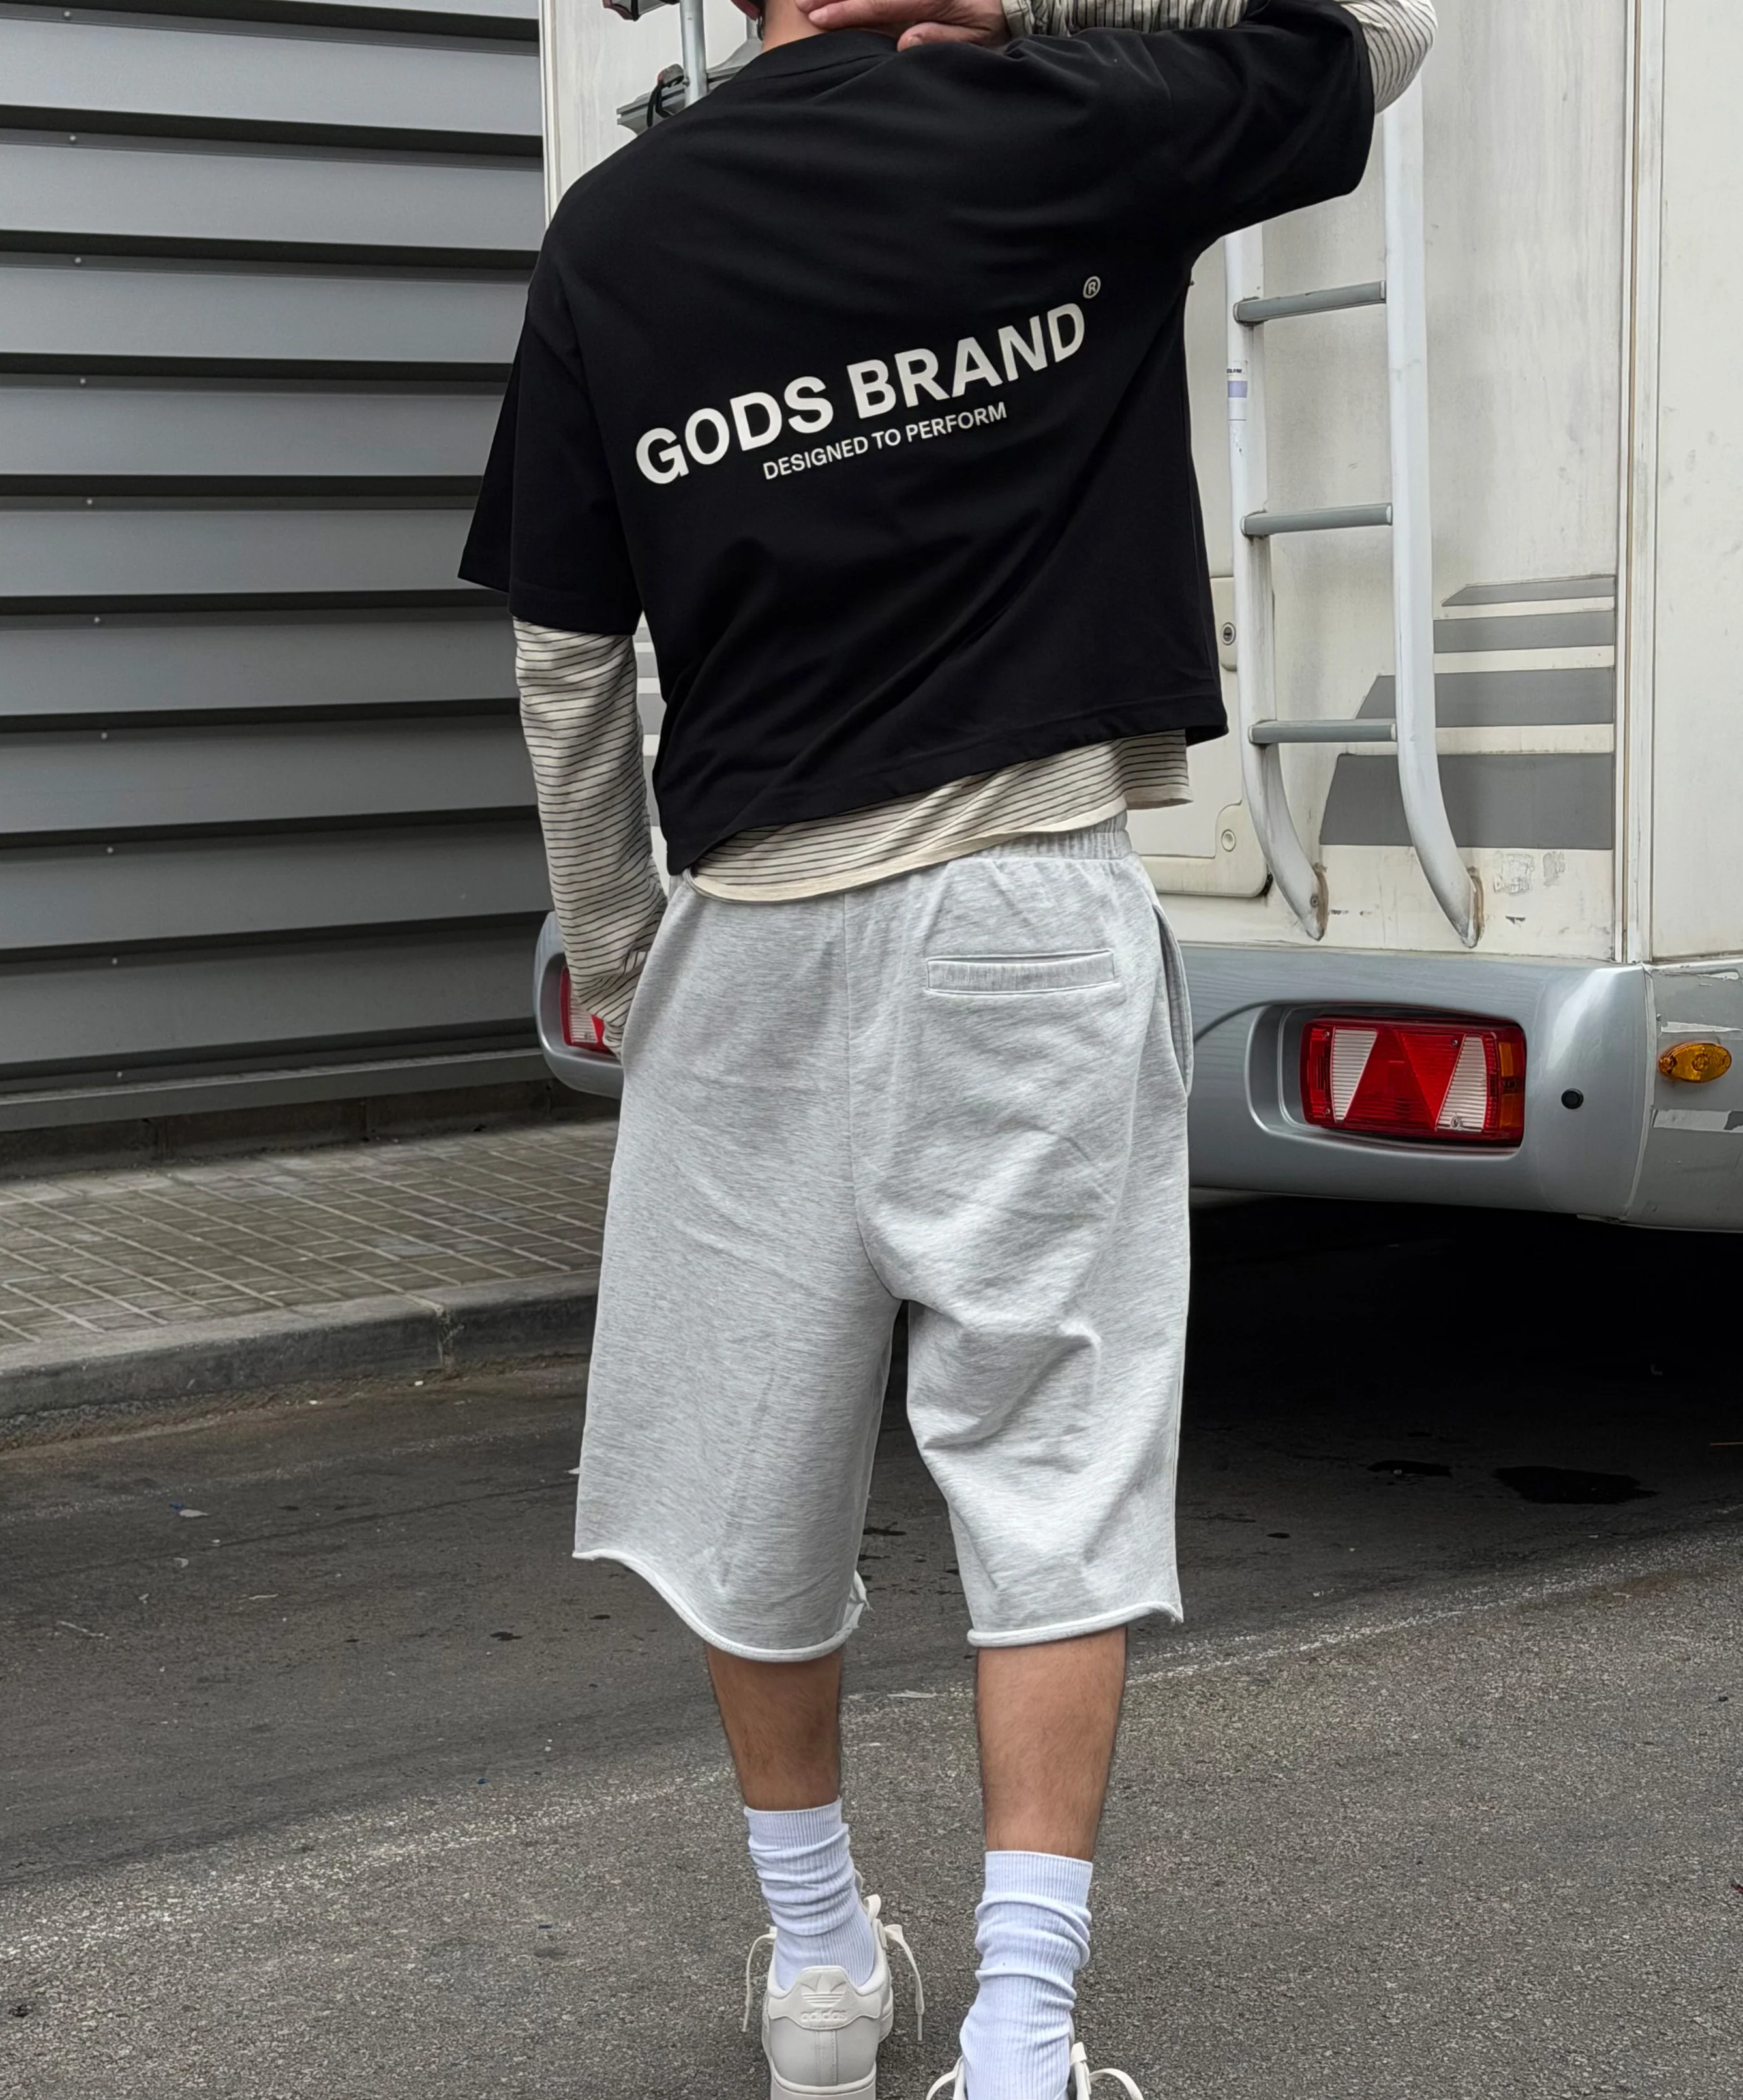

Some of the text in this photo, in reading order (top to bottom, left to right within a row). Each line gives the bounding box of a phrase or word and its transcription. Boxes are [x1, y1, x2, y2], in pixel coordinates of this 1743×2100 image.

[635, 375, 834, 485] GODS
[845, 303, 1085, 420] BRAND
[762, 400, 1008, 481] DESIGNED TO PERFORM
[800, 2008, 847, 2022] adidas
